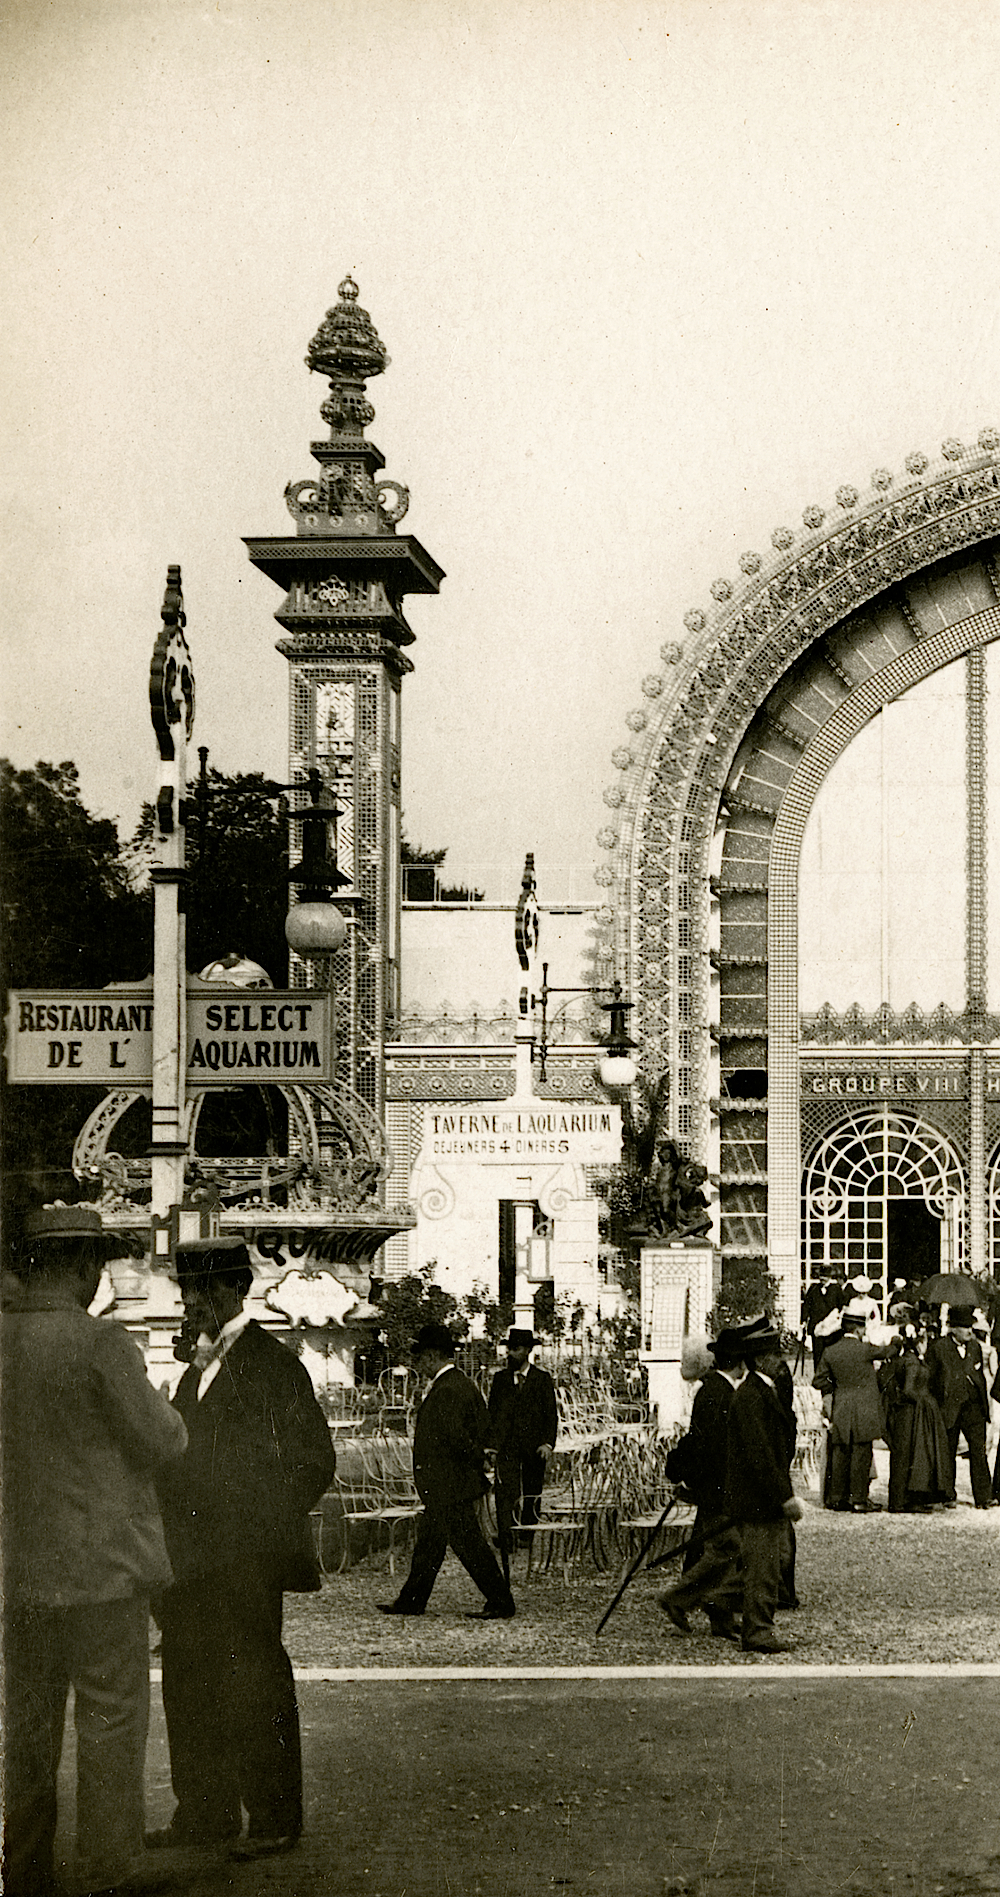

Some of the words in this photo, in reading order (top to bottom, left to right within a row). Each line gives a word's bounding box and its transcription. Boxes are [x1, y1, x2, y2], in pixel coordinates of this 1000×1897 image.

[18, 1001, 154, 1032] RESTAURANT
[206, 1004, 312, 1031] SELECT
[47, 1041, 83, 1068] DE
[188, 1038, 321, 1071] AQUARIUM
[812, 1077, 907, 1095] GROUPE
[916, 1077, 958, 1093] VIII
[431, 1114, 500, 1135] TAVERNE
[502, 1122, 514, 1133] DE
[515, 1140, 556, 1153] DINERS
[558, 1140, 570, 1154] 5
